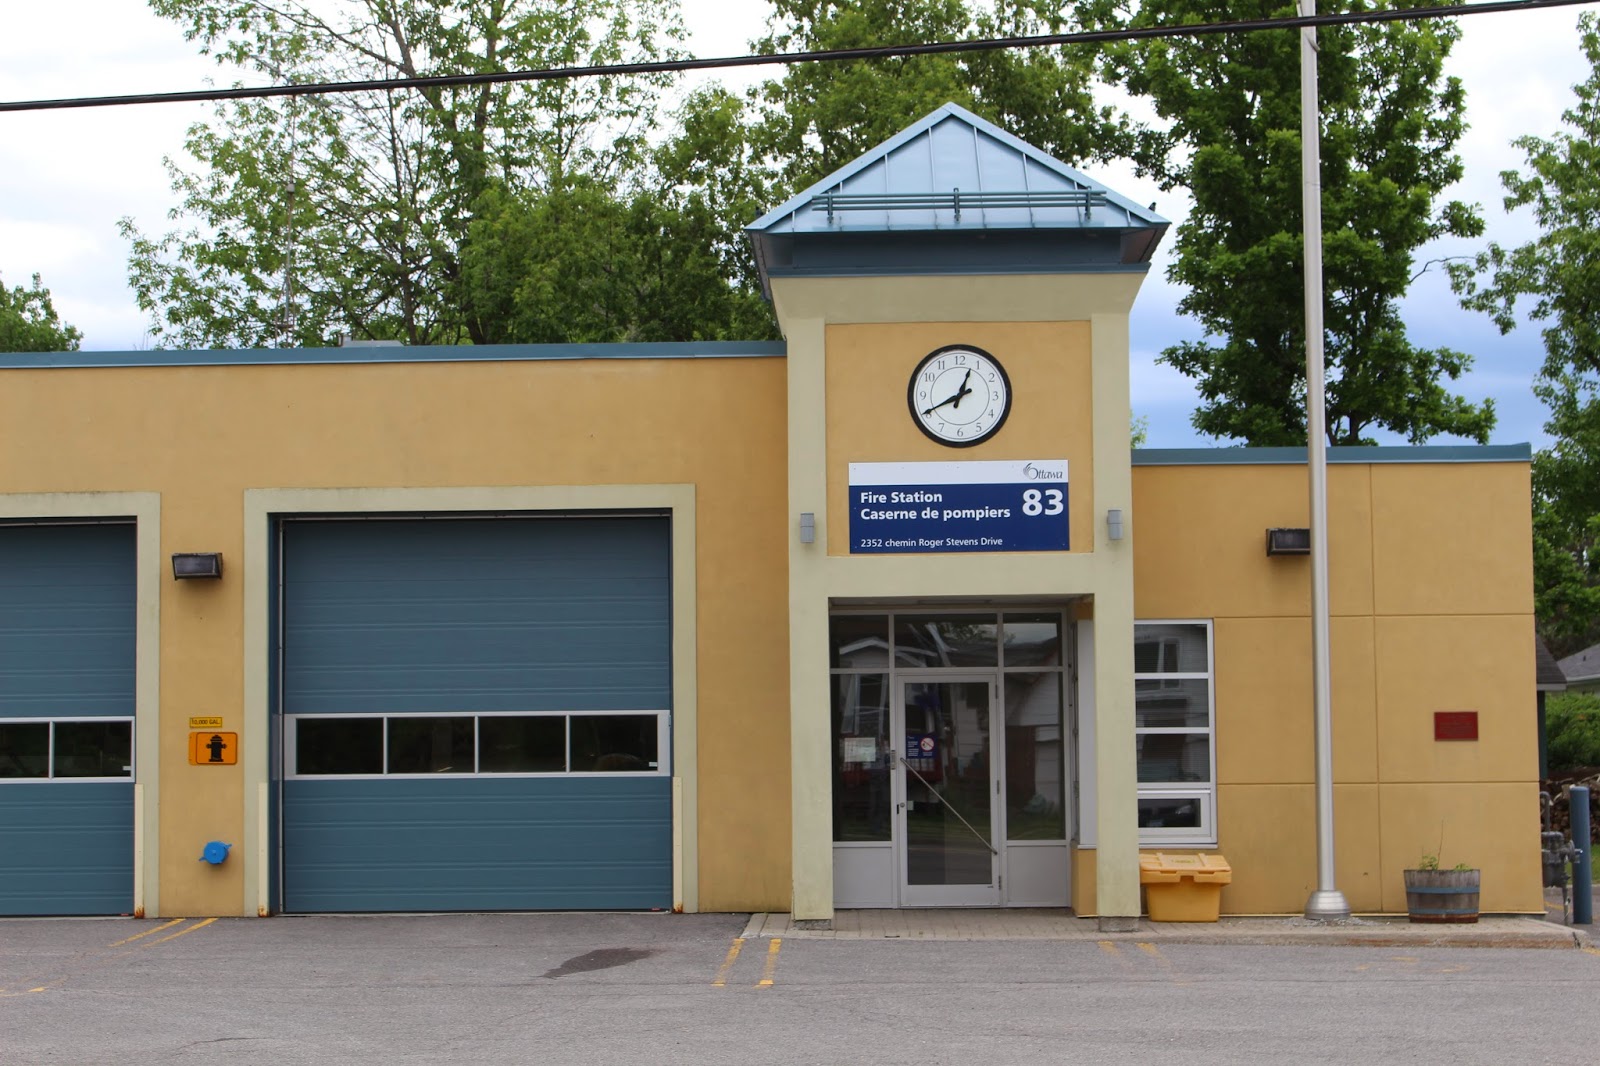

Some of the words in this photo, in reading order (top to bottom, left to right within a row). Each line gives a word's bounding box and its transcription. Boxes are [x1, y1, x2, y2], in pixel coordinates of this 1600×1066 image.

[937, 360, 945, 370] 11
[955, 356, 965, 366] 12
[976, 361, 980, 370] 1
[924, 372, 935, 382] 10
[988, 373, 995, 382] 2
[920, 391, 927, 400] 9
[993, 391, 999, 401] 3
[988, 409, 994, 418] 4
[938, 422, 944, 432] 7
[957, 427, 963, 437] 6
[975, 423, 982, 432] 5
[1024, 462, 1063, 480] Ottawa
[860, 491, 887, 504] Fire
[891, 491, 943, 503] Station
[1022, 488, 1064, 516] 83
[860, 508, 917, 520] Caserne
[921, 507, 939, 519] de
[943, 506, 1011, 521] pompiers
[860, 538, 883, 548] 2352
[885, 538, 917, 547] chemin
[918, 538, 944, 549] Roger
[946, 537, 979, 547] Stevens
[980, 536, 1003, 546] Drive
